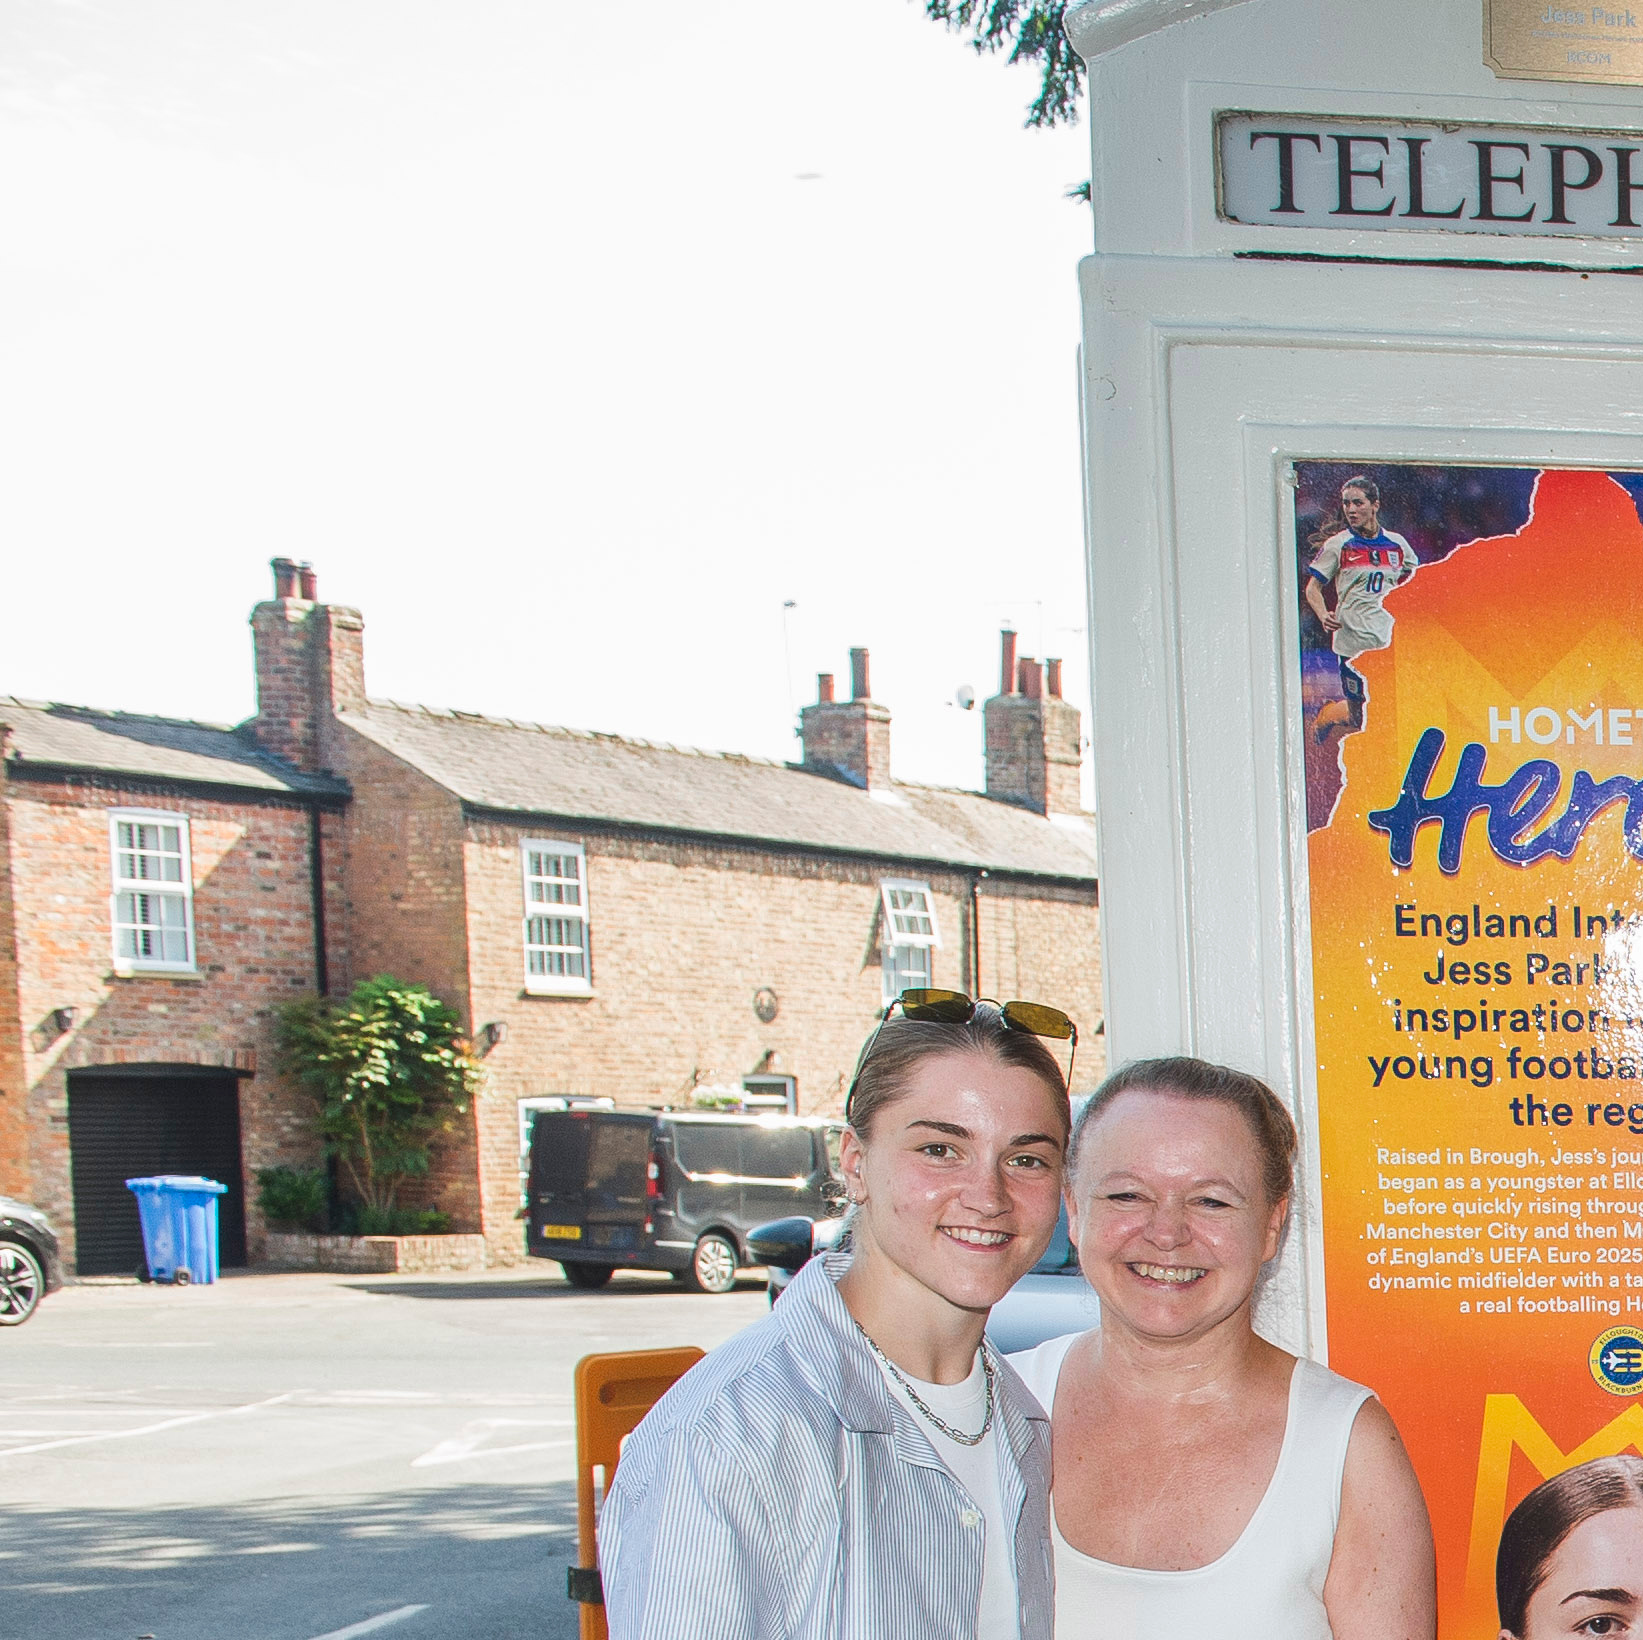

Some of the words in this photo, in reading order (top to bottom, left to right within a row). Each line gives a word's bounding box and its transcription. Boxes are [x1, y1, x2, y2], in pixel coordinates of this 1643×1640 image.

[1541, 5, 1585, 25] Jess
[1592, 7, 1637, 27] Park
[1567, 51, 1611, 64] KCOM
[1366, 571, 1384, 593] 10
[1395, 904, 1557, 946] England
[1423, 952, 1512, 985] Jess
[1394, 998, 1610, 1040] inspiration
[1368, 1055, 1494, 1087] young
[1509, 1094, 1573, 1126] the
[1377, 1147, 1441, 1165] Raised
[1446, 1147, 1464, 1165] in
[1469, 1147, 1546, 1169] Brough,
[1550, 1147, 1607, 1166] Jess's
[1378, 1172, 1439, 1194] began
[1444, 1177, 1465, 1190] as
[1470, 1177, 1481, 1190] a
[1486, 1173, 1585, 1194] youngster
[1588, 1173, 1608, 1190] at
[1383, 1197, 1447, 1215] before
[1452, 1197, 1523, 1218] quickly
[1528, 1197, 1582, 1218] rising
[1366, 1222, 1483, 1240] Manchester
[1487, 1221, 1529, 1243] City
[1533, 1221, 1569, 1239] and
[1574, 1221, 1618, 1239] then
[1366, 1247, 1387, 1265] of
[1392, 1247, 1484, 1269] England's
[1489, 1246, 1542, 1264] UEFA
[1547, 1246, 1591, 1264] Euro
[1596, 1247, 1643, 1264] 2025
[1368, 1271, 1452, 1293] dynamic
[1457, 1270, 1557, 1289] midfielder
[1561, 1271, 1604, 1288] with
[1608, 1275, 1620, 1288] a
[1459, 1300, 1471, 1314] a
[1476, 1296, 1512, 1313] real
[1517, 1295, 1621, 1317] footballing
